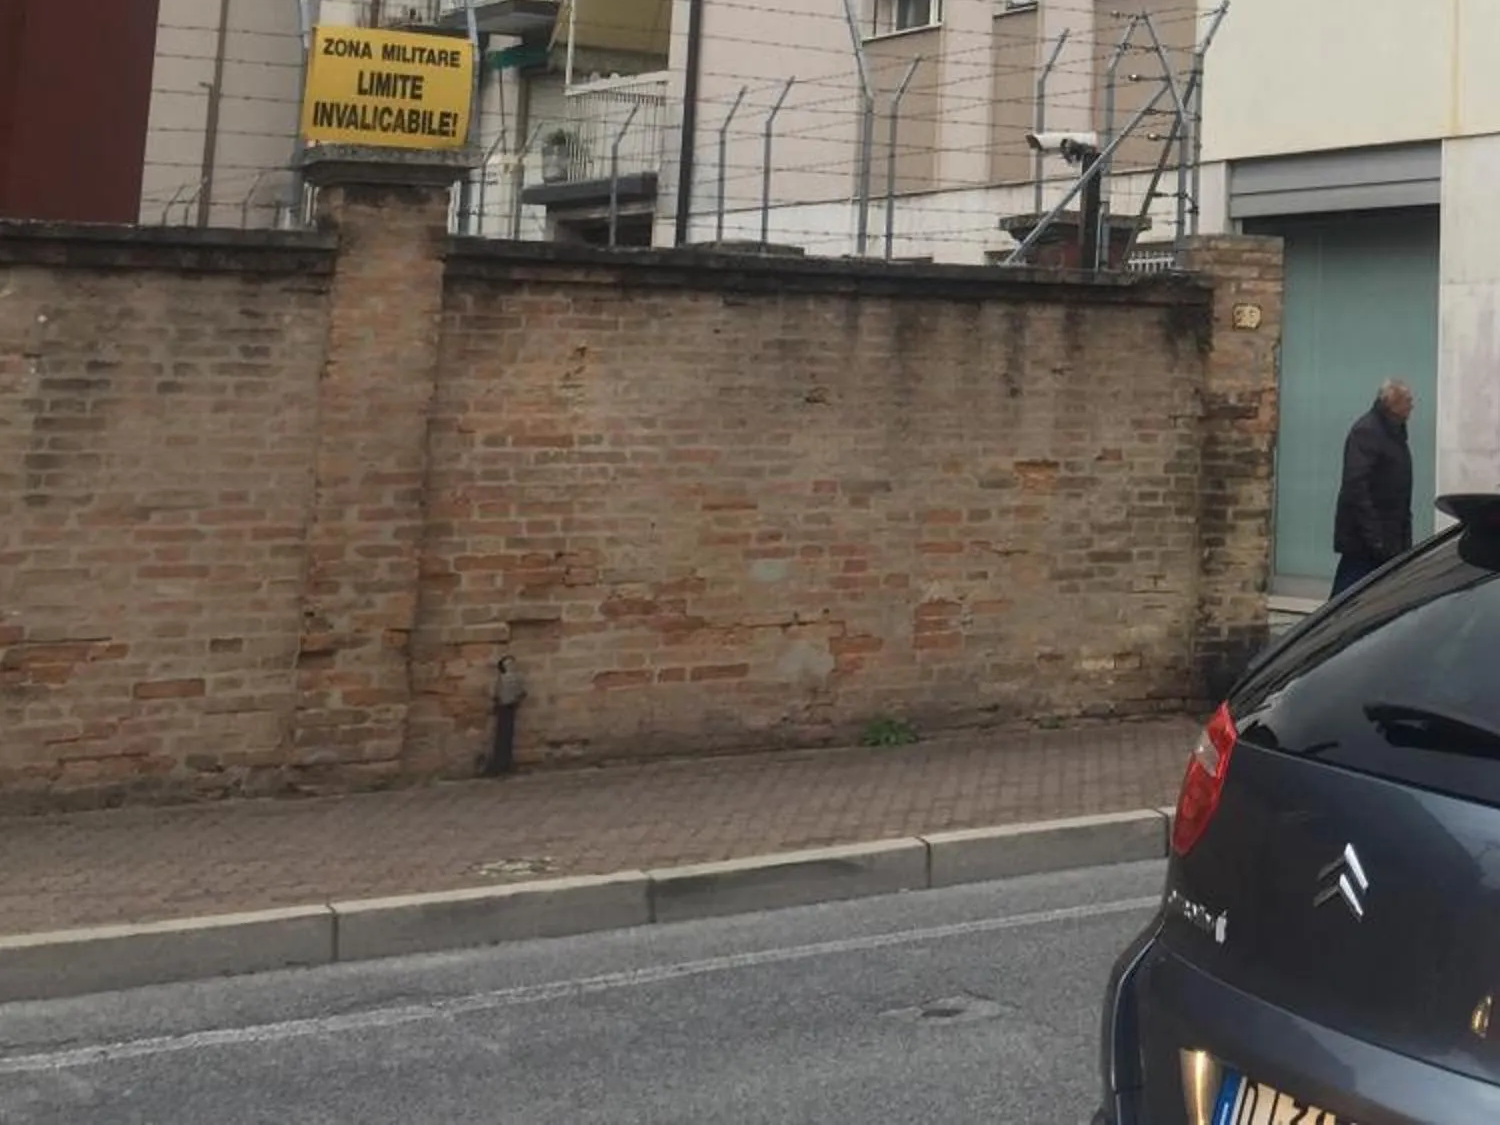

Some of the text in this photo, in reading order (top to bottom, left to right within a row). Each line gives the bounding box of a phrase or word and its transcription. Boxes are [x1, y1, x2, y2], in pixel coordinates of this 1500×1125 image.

[323, 38, 461, 68] ZONA MILITARE
[357, 70, 425, 101] LIMITE
[312, 101, 459, 138] INVALICABILE!
